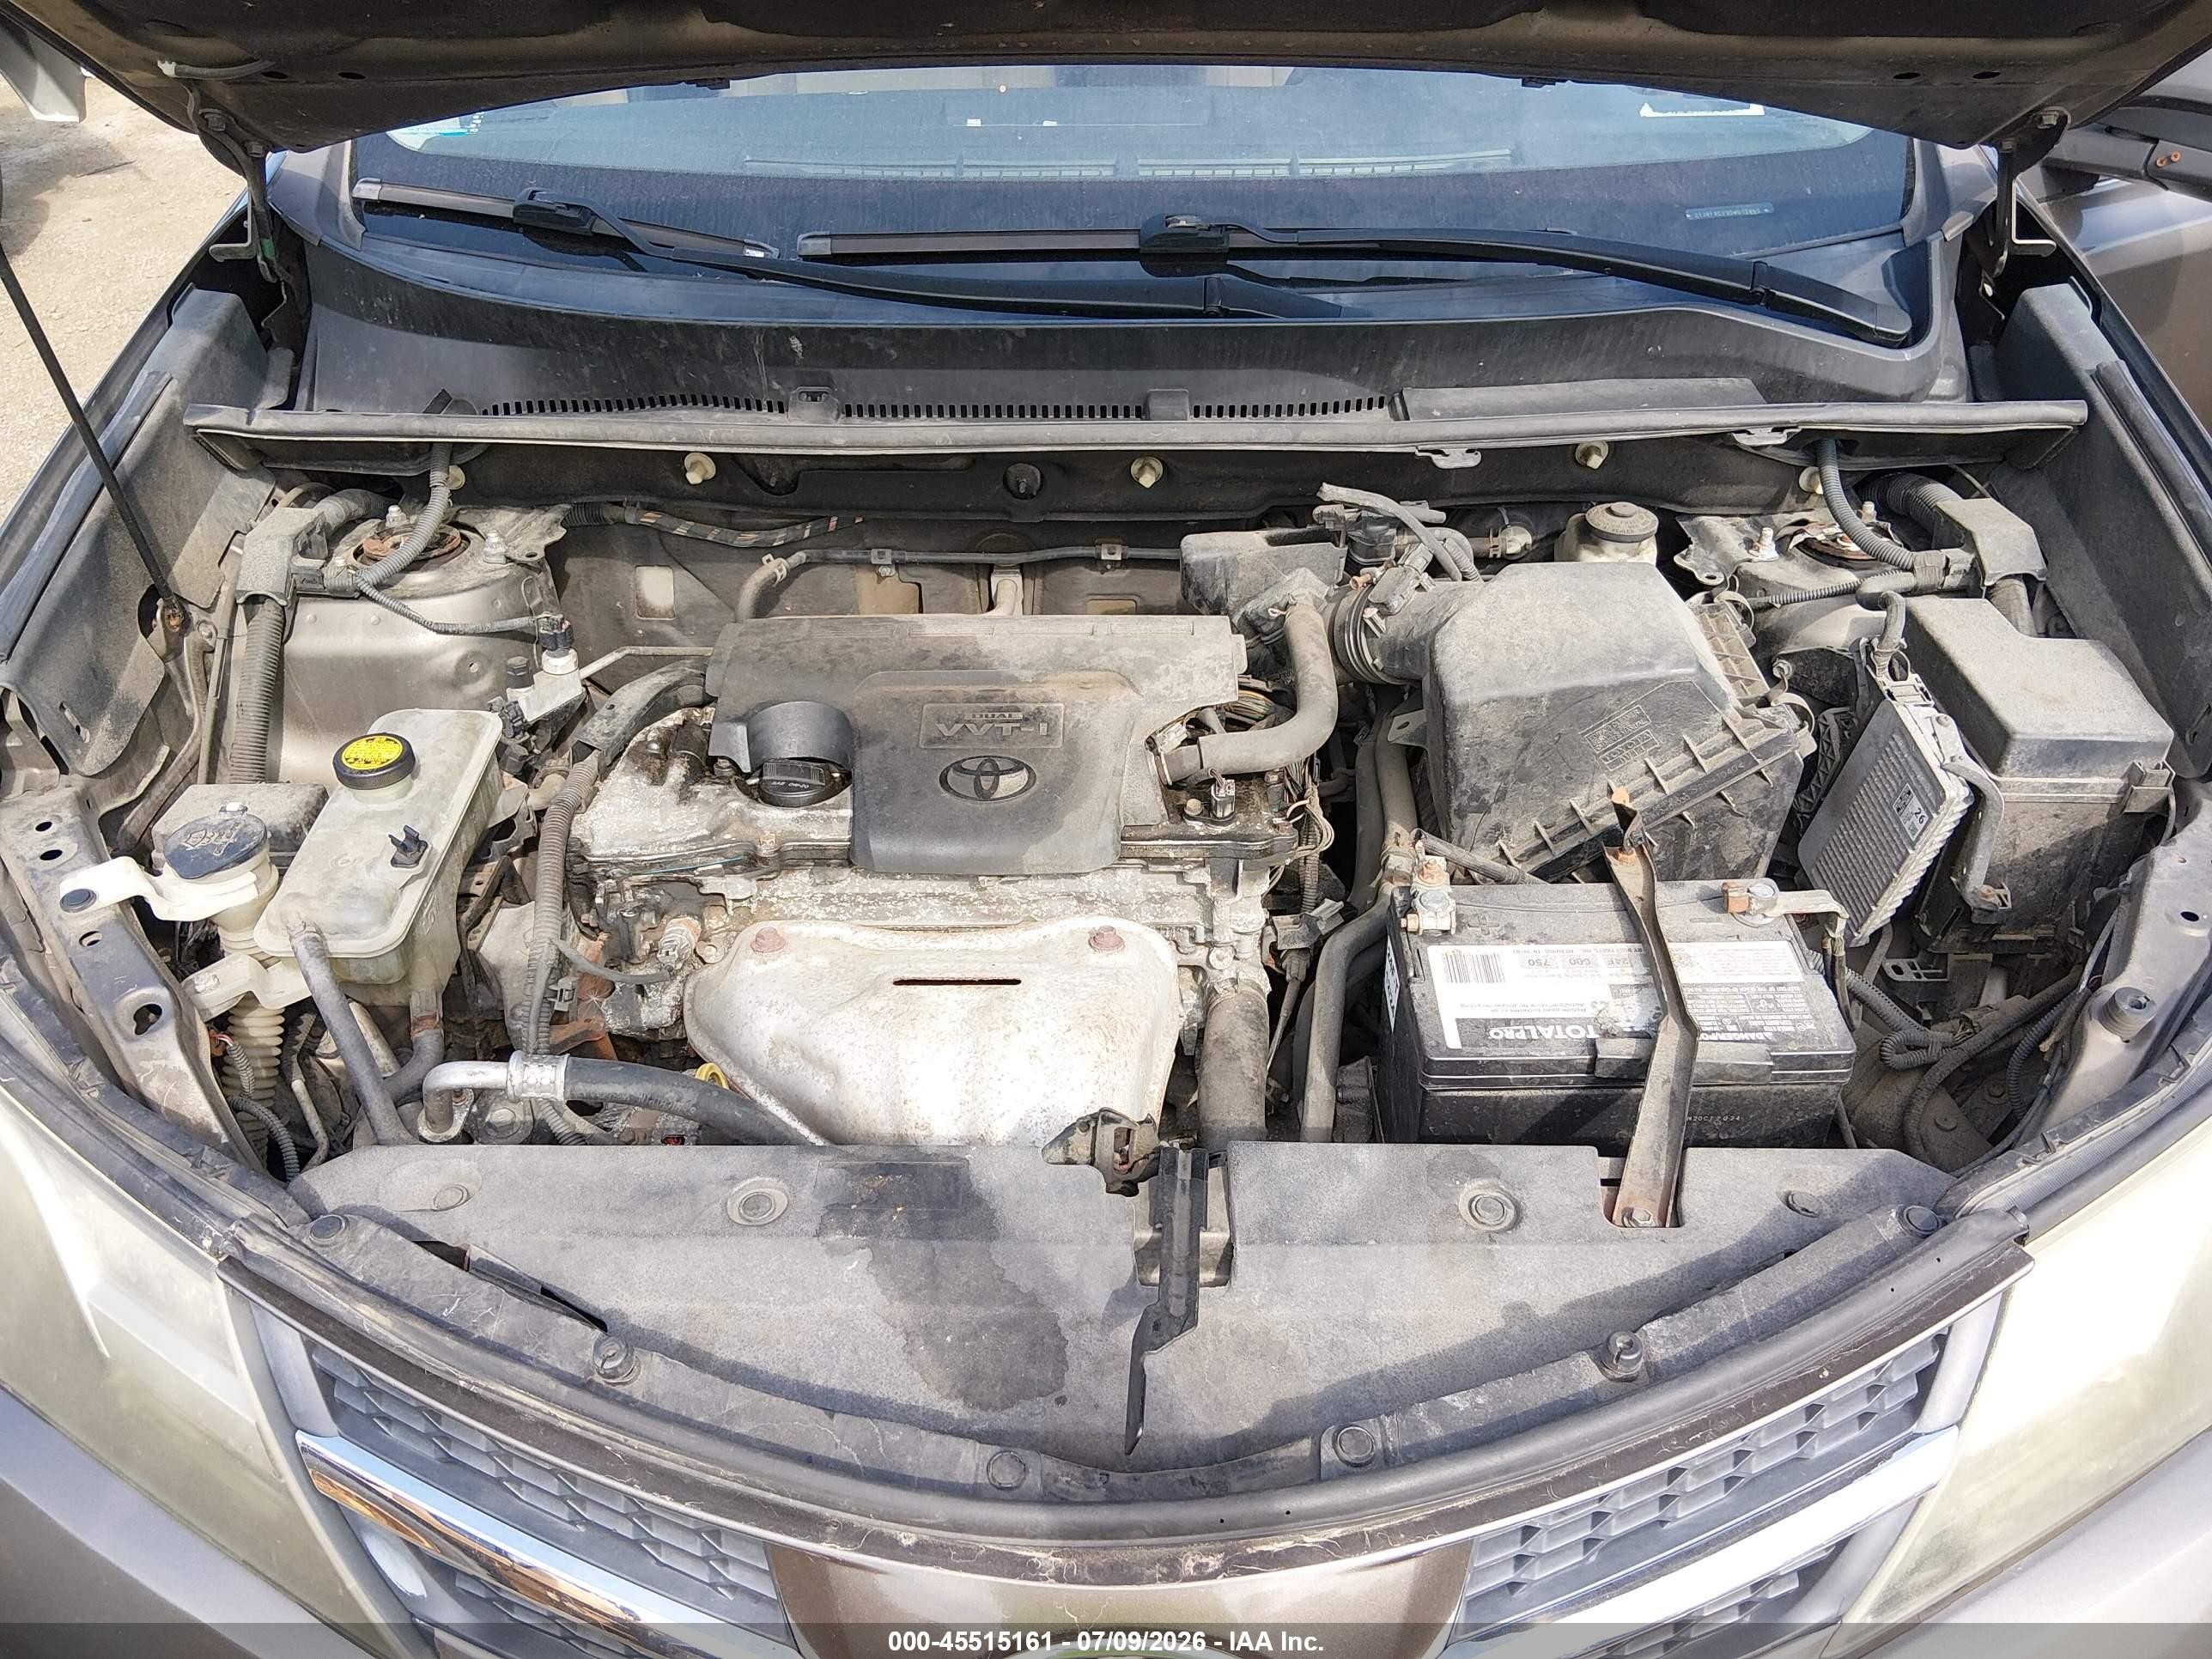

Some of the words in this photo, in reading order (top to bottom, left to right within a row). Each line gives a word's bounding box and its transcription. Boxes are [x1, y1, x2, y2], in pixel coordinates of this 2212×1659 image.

[969, 712, 1019, 720] DUAL
[1914, 807, 1926, 824] 26
[1528, 957, 1550, 967] 750
[1489, 1024, 1601, 1040] TOTALPRO
